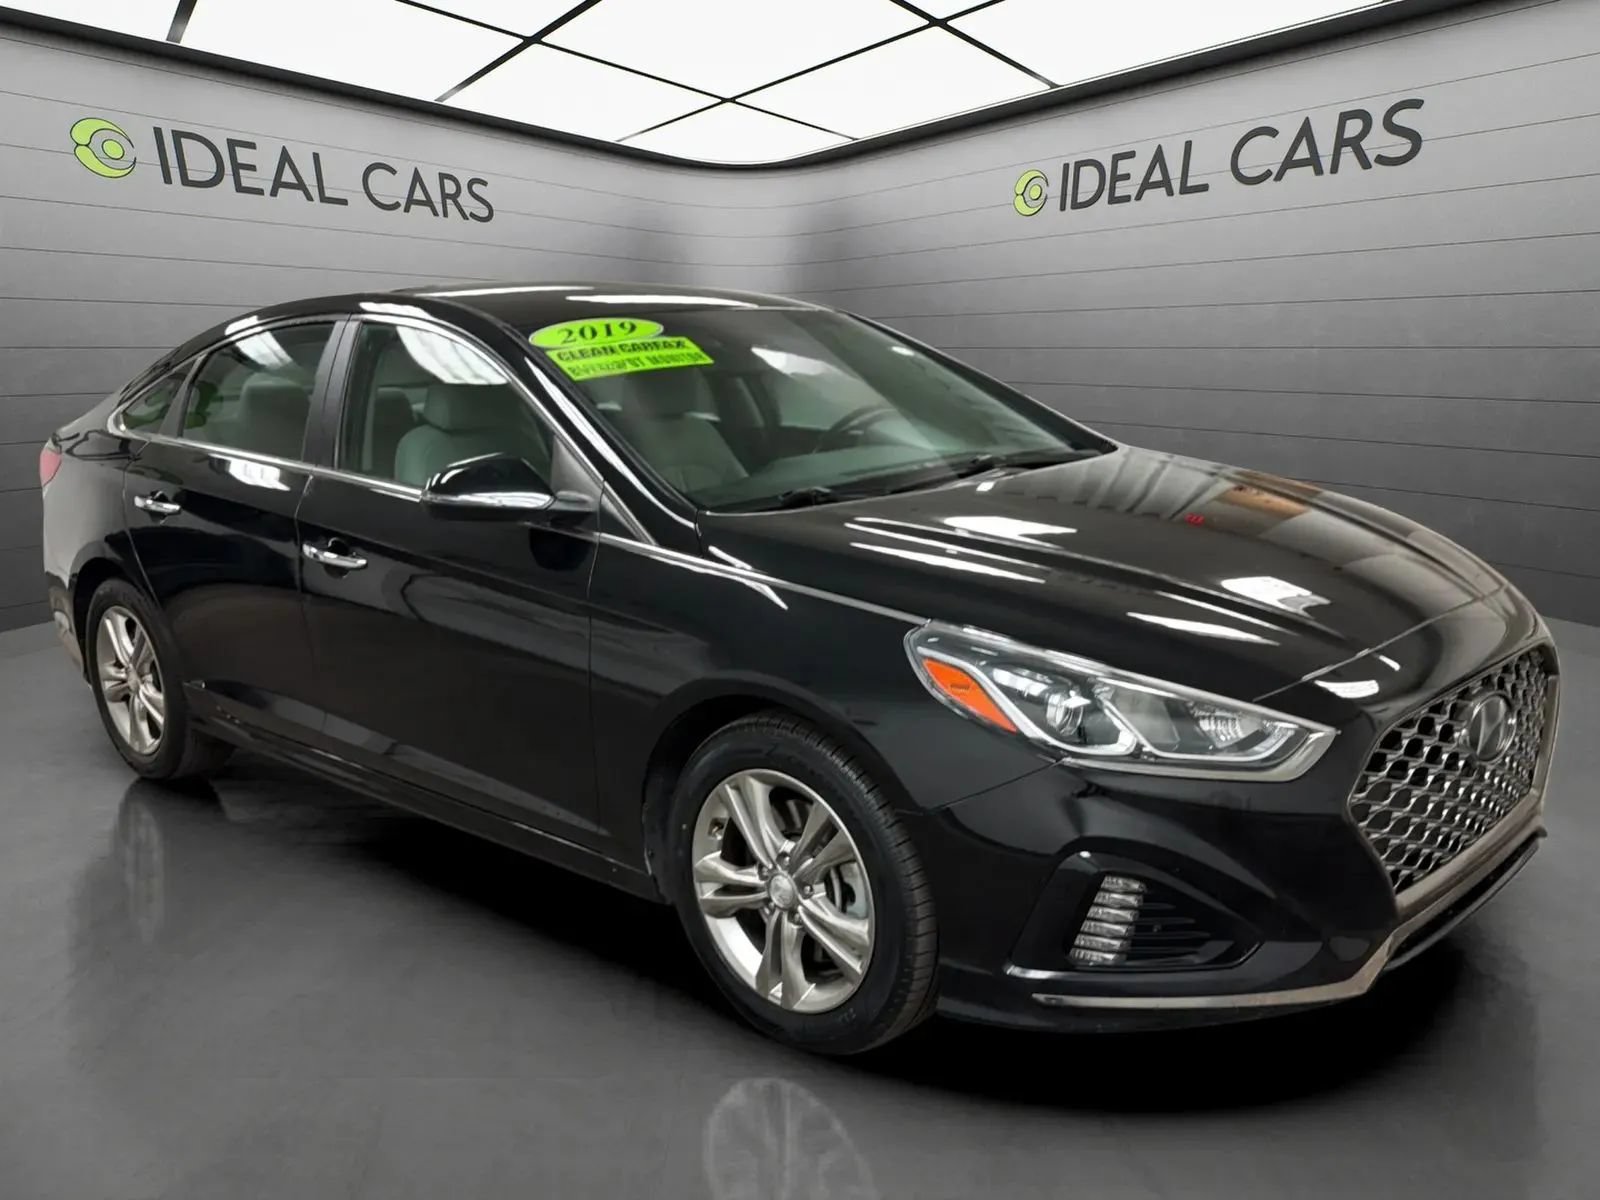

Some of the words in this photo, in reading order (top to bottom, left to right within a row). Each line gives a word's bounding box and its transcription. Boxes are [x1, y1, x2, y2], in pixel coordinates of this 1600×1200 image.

[152, 126, 348, 207] IDEAL
[362, 161, 495, 223] CARS
[1059, 139, 1209, 212] IDEAL
[1230, 98, 1425, 186] CARS
[556, 345, 616, 363] CLEAN
[617, 339, 688, 354] CARFAX
[557, 320, 637, 345] 2019
